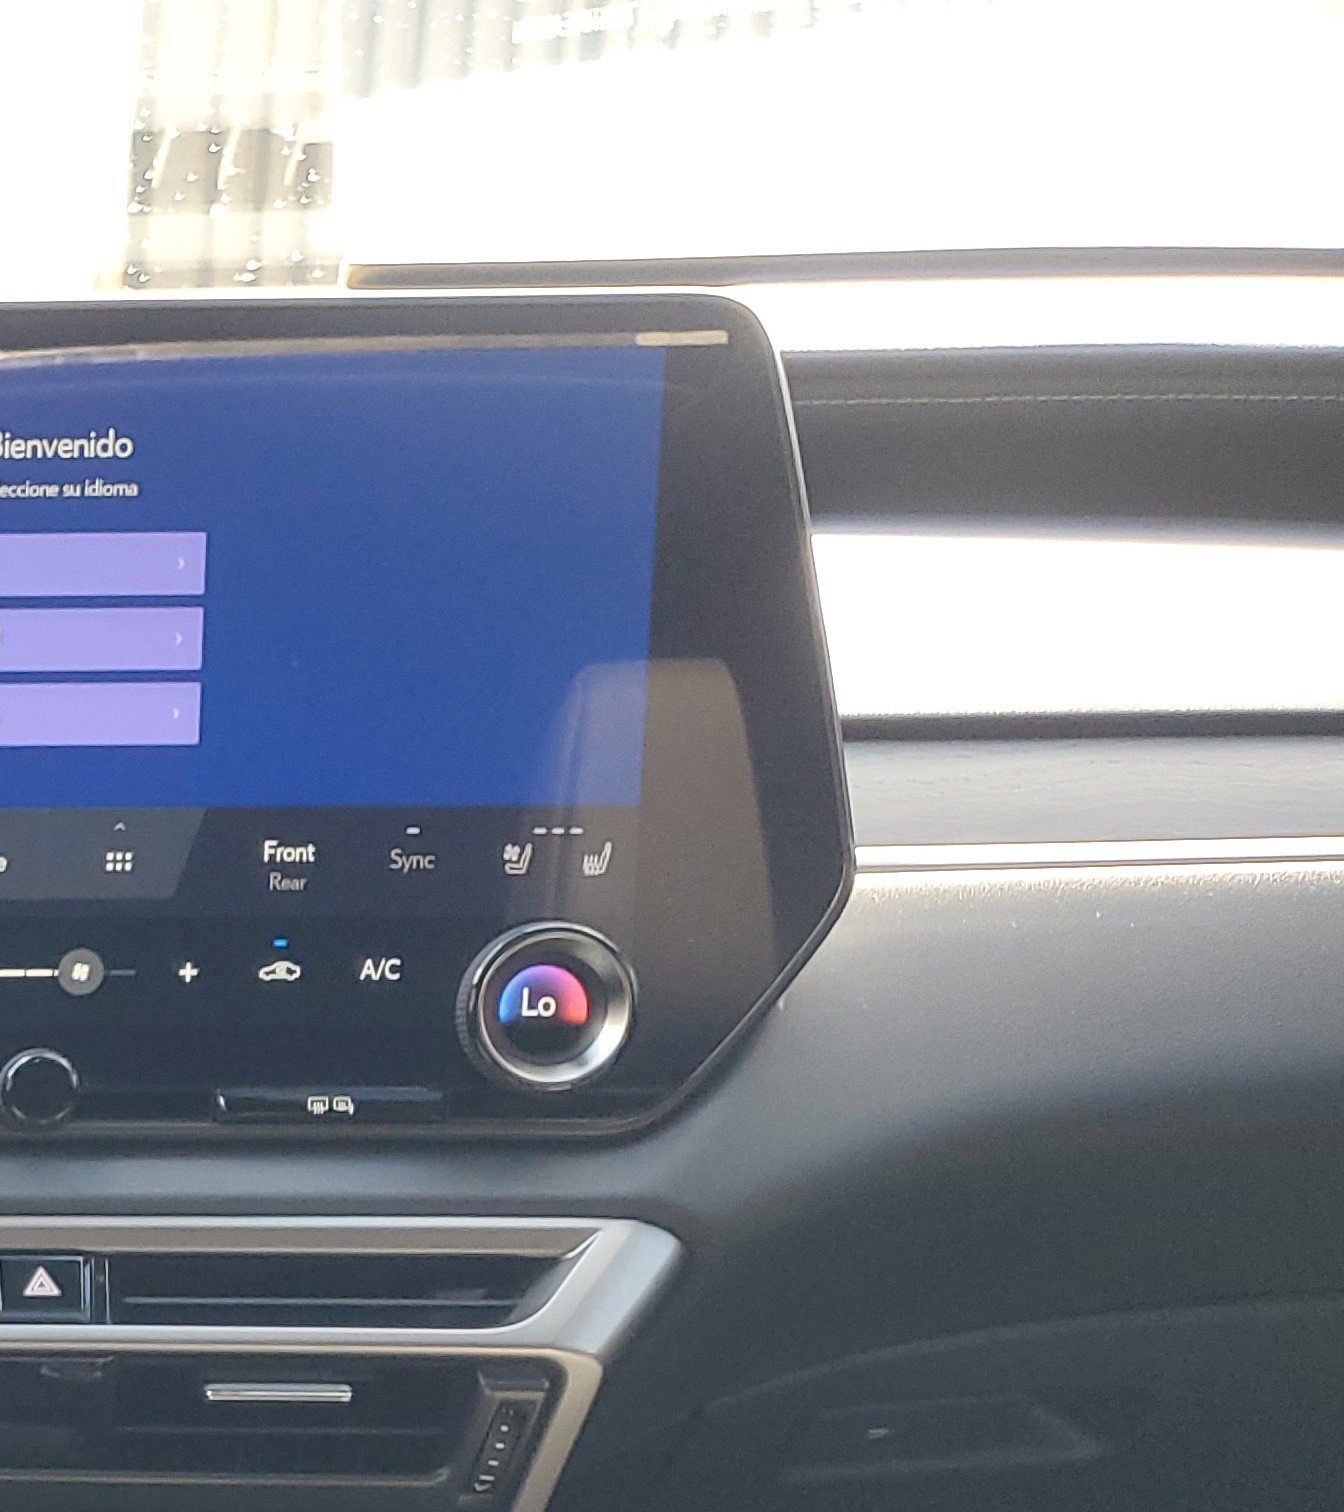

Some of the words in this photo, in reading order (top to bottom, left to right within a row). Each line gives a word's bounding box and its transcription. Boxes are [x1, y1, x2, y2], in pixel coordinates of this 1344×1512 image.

[63, 483, 81, 497] su
[84, 478, 139, 497] idioma
[263, 841, 316, 863] Front
[389, 848, 435, 871] Sync
[269, 872, 307, 891] Rear
[359, 958, 402, 982] A/C
[522, 987, 557, 1018] Lo
